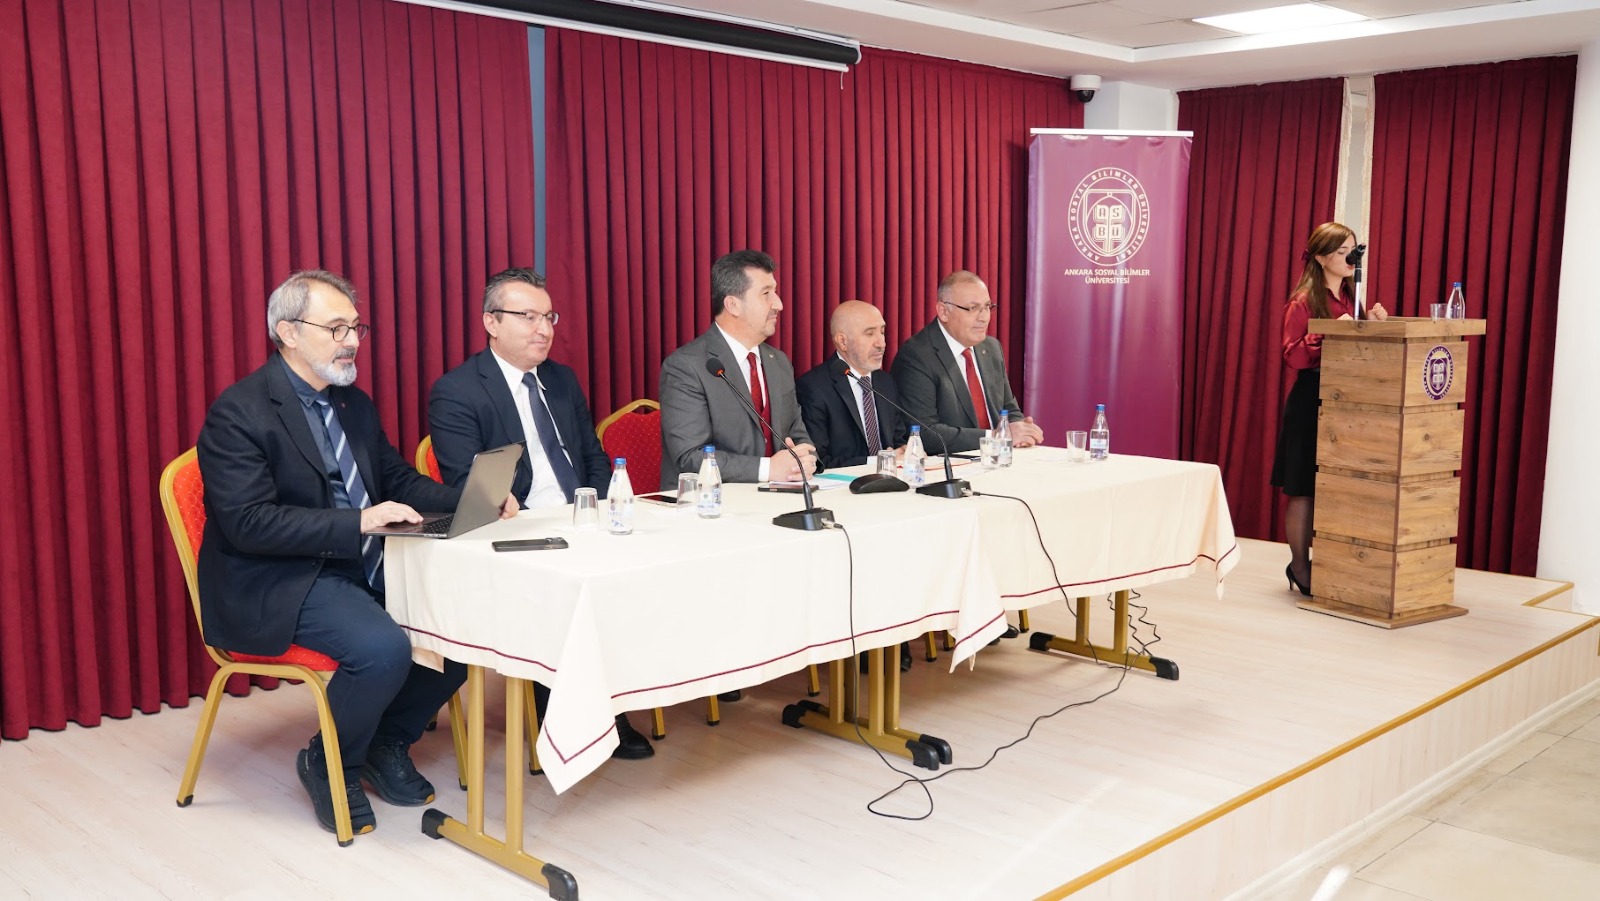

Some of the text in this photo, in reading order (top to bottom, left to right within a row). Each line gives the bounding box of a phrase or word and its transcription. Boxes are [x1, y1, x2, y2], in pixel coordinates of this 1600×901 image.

[1091, 169, 1139, 190] BİLİMLER
[1070, 183, 1088, 220] SOSYAL
[1072, 228, 1100, 261] ANKARA
